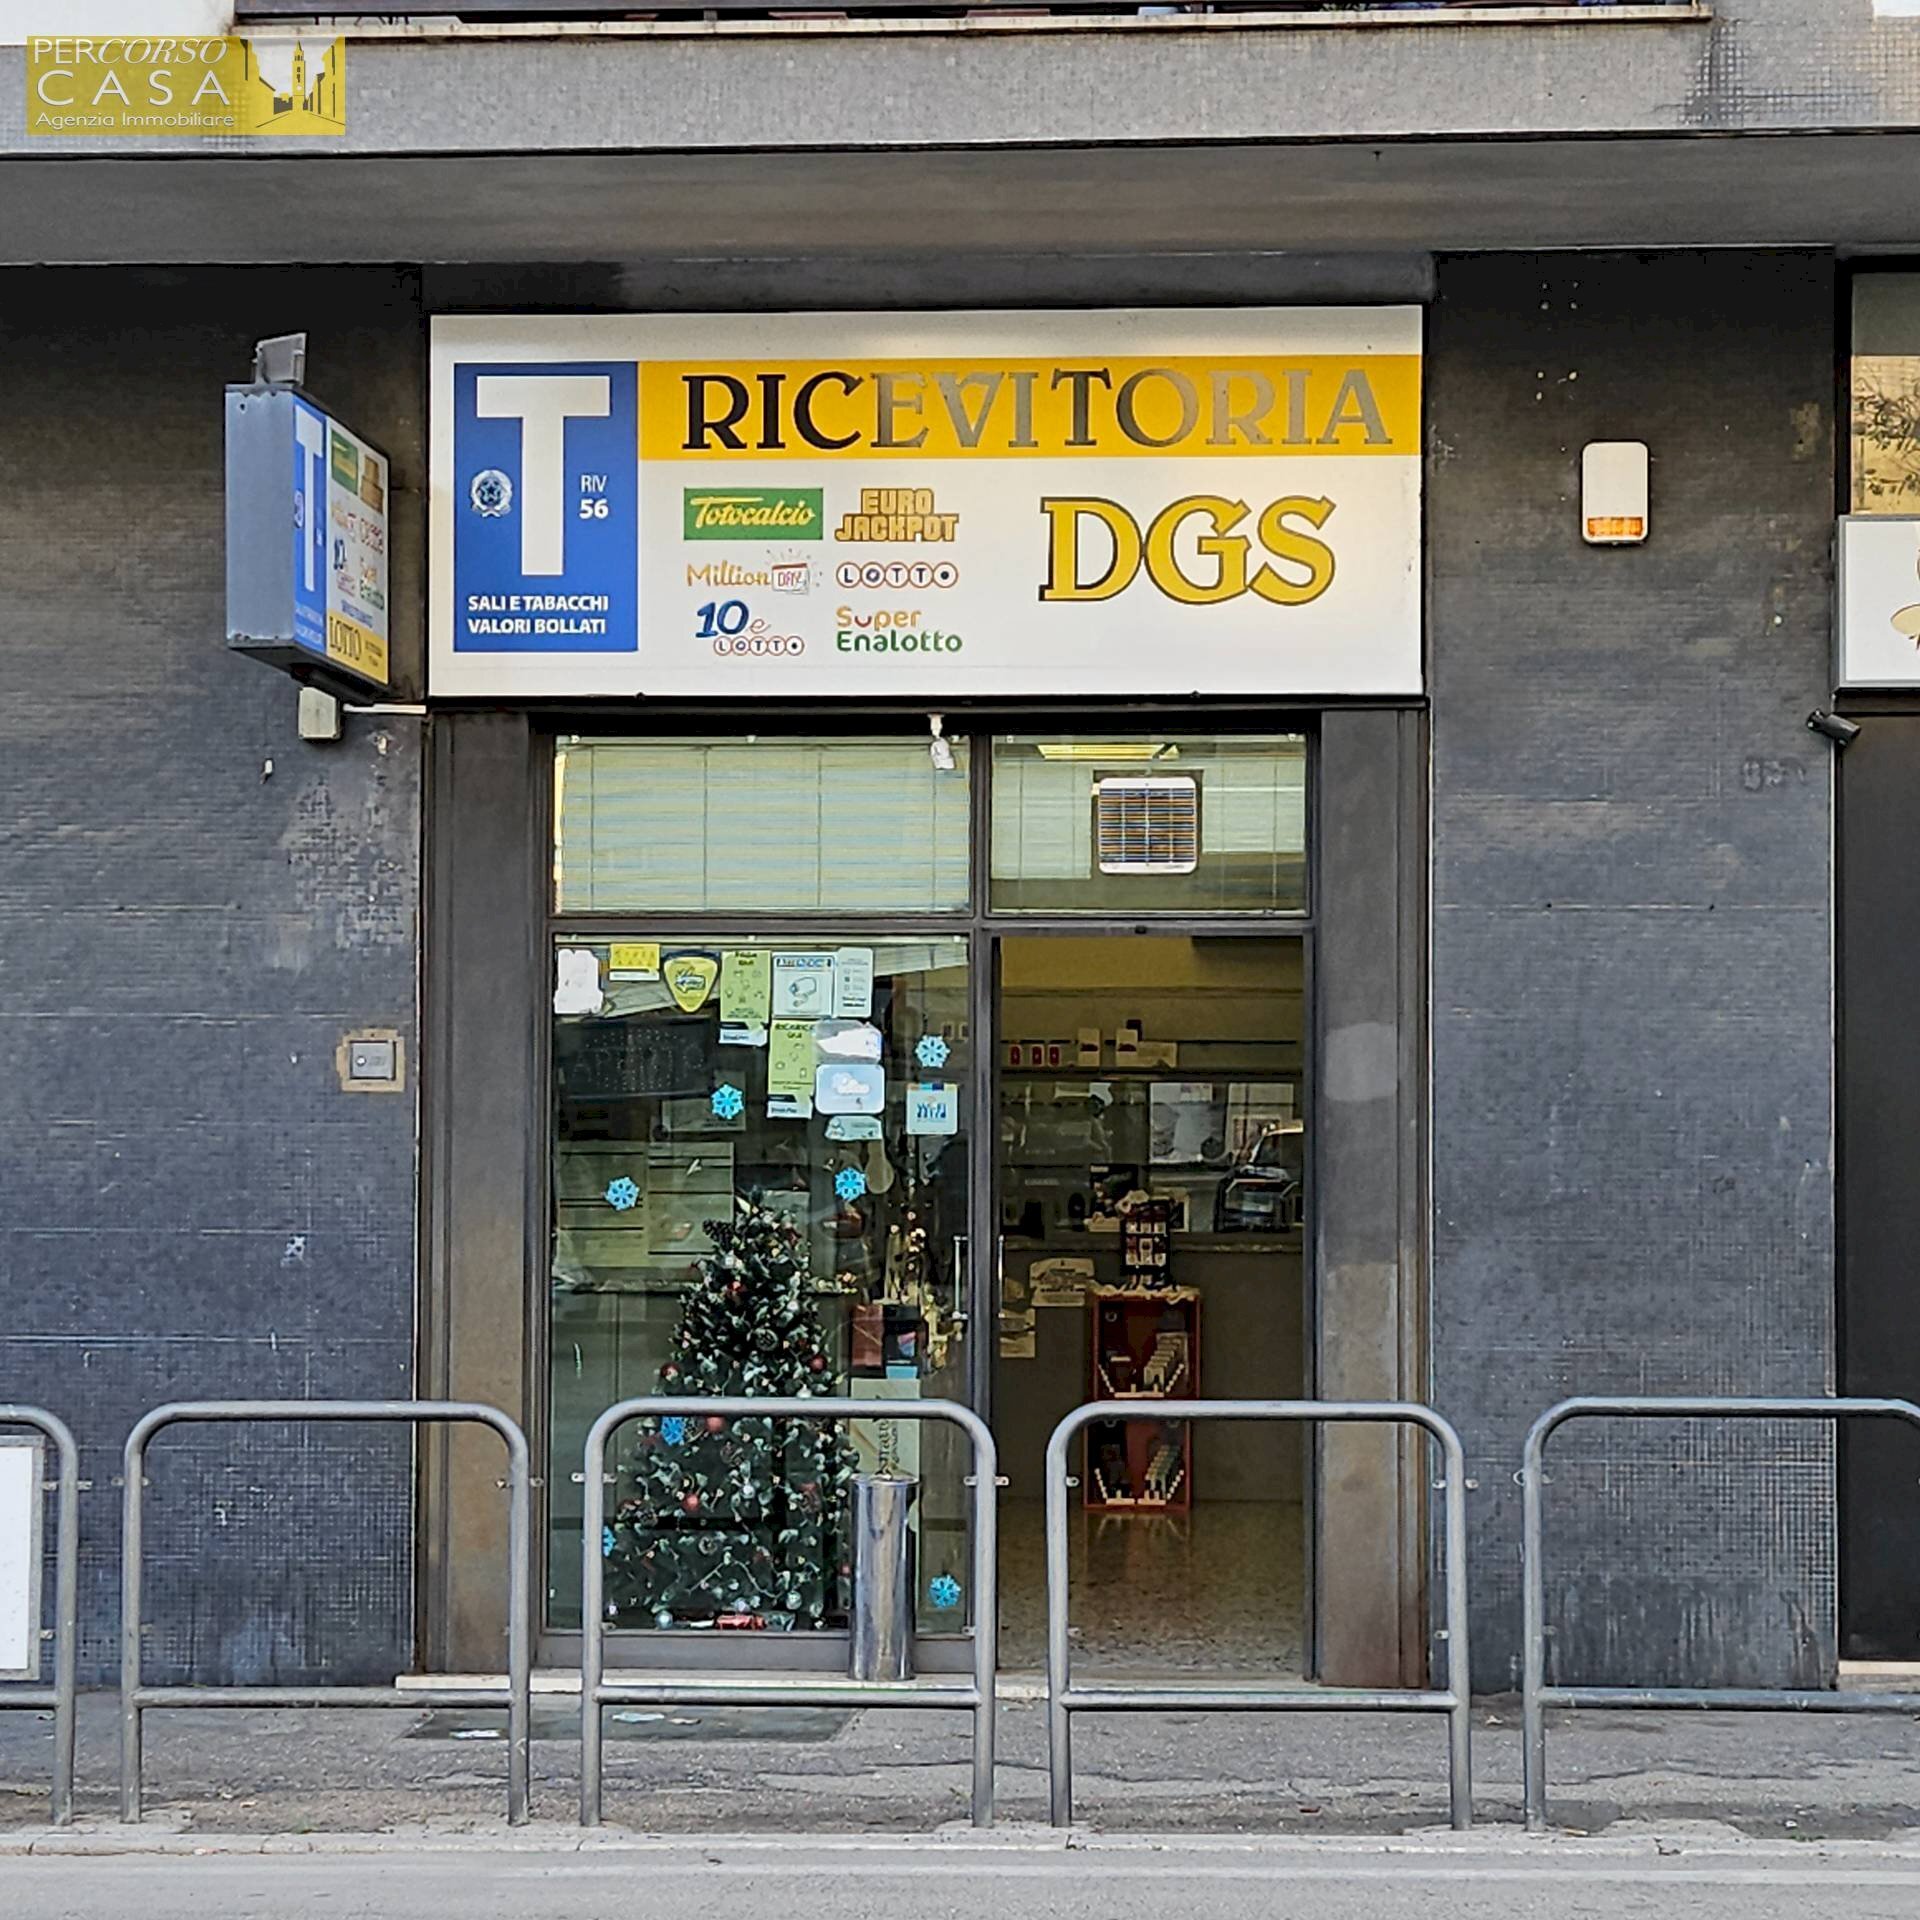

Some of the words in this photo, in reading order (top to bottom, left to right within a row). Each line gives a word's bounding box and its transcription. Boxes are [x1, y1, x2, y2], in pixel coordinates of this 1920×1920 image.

[682, 368, 1392, 449] RICEVITORIA
[476, 375, 611, 576] T
[581, 475, 607, 493] RIV
[579, 498, 609, 519] 56
[690, 496, 816, 528] Totocalcio
[861, 488, 934, 515] EURO
[834, 513, 960, 542] JACKPOT
[1038, 494, 1336, 606] DGS
[687, 560, 771, 587] Million
[836, 562, 958, 588] LOTTO
[468, 595, 506, 611] SALI
[510, 595, 521, 611] E
[523, 595, 608, 611] TABACCHI
[467, 618, 530, 634] VALORI
[534, 618, 606, 634] BOLLATI
[695, 600, 750, 638] 10
[836, 606, 922, 632] Super
[714, 635, 805, 656] LOTTO
[837, 629, 962, 652] Enalotto
